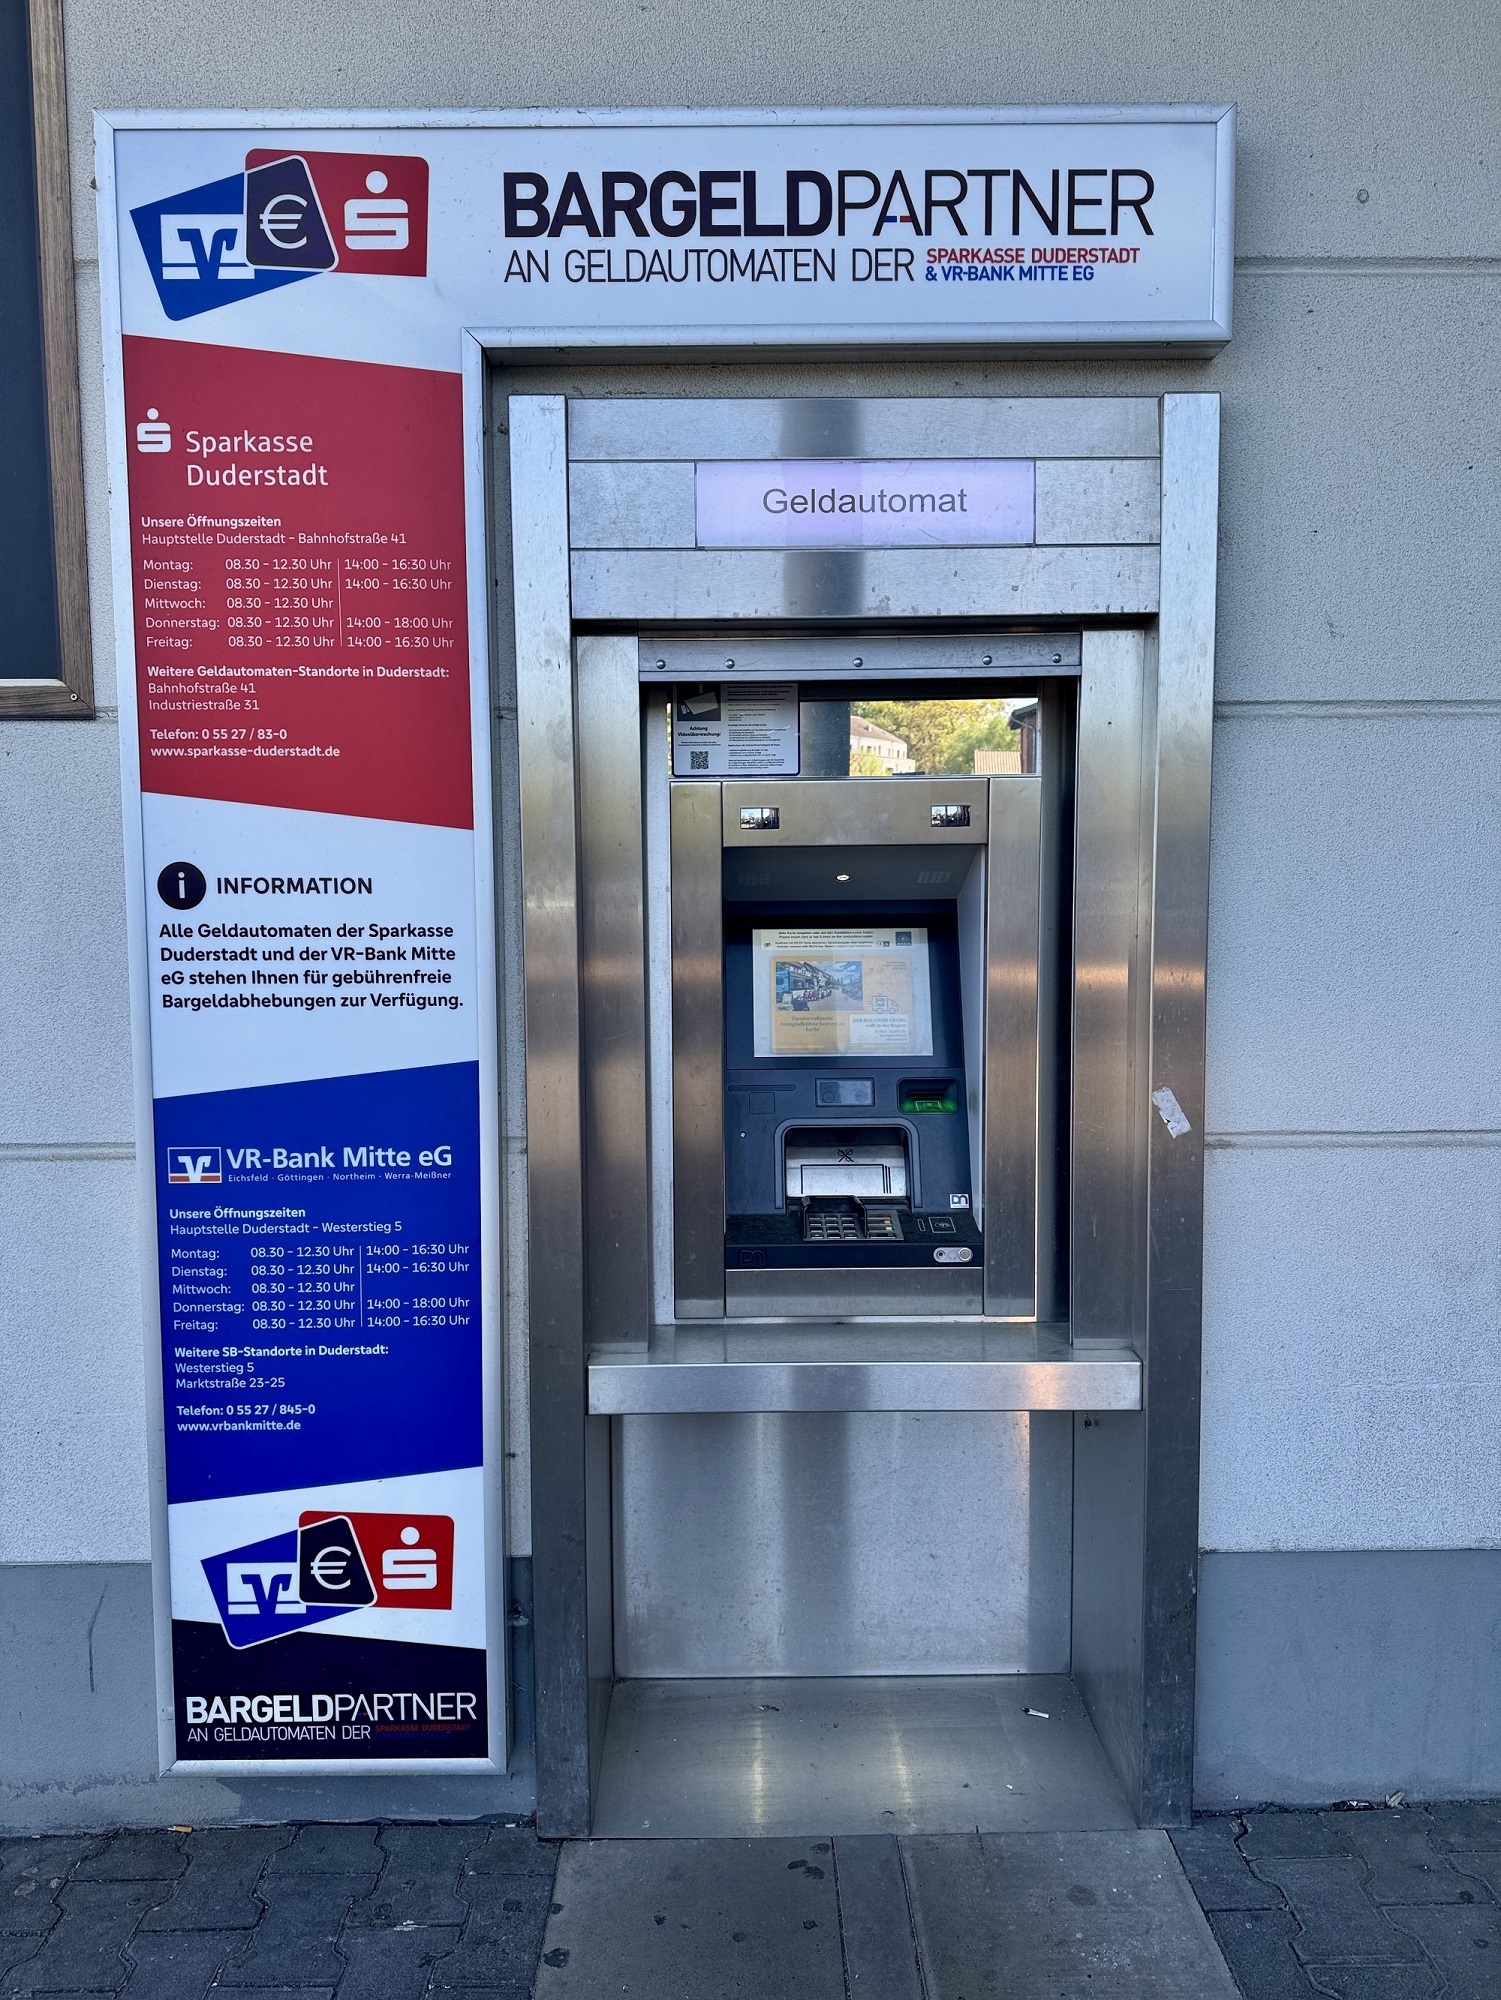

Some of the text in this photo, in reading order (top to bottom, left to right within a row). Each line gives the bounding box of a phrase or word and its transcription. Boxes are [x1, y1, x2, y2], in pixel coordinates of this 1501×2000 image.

[504, 169, 1154, 237] BARGELDPARTNER
[927, 248, 1140, 263] SPARKASSE DUDERSTADT
[504, 248, 914, 282] AN GELDAUTOMATEN DER
[926, 266, 1094, 281] & VR-BANK MITTE EG
[186, 430, 312, 458] Sparkasse
[188, 463, 328, 485] Duderstadt
[763, 489, 967, 513] Geldautomat
[142, 516, 281, 529] Unsere Öffnungszeiten
[143, 533, 406, 546] Hauptstelle Duderstadt Bahnhofstraße 41
[144, 559, 451, 572] Montag: 08.30 12.30 Uhr 14:00 16:30 Uhr
[145, 578, 452, 591] Dienstag: 08.30 12.30 Uhr 14:00 16:30 Uhr
[146, 598, 333, 608] Mittwoch: 08.30 12.30 Uhr
[146, 617, 453, 630] Donnerstag: 08.30 12.30 Uhr 14:00 18:00 Uhr
[147, 636, 454, 649] Freitag: 08.30 12.30 Uhr 14:00 16:30 Uhr
[148, 666, 449, 677] Weitere Geldautomaten-Standorte in Duderstadt:
[149, 682, 256, 693] Bahnhofstraße 41
[150, 699, 259, 710] Industriestraße 31
[150, 729, 287, 739] Telefon: 0 55 27 83-0
[151, 746, 340, 758] www.sparkasse-duderstadt.de
[217, 877, 372, 894] INFORMATION
[159, 923, 453, 940] Alle Geldautomaten der Sparkasse
[161, 946, 455, 961] Duderstadt und der VR-Bank Mitte
[161, 969, 451, 987] eG stehen Ihnen für gebührenfreie
[163, 993, 463, 1011] Bargeldabhebungen zur Verfügung.
[226, 1146, 451, 1168] VR-Bank Mitte eG
[229, 1174, 268, 1182] Eichsfeld
[278, 1174, 323, 1182] Göttingen
[385, 1171, 451, 1179] Werra-Meißner
[170, 1206, 305, 1220] Unsere Öffnungszeiten
[171, 1221, 402, 1236] Hauptstelle Duderstadt Westerstieg 5
[172, 1244, 469, 1260] Montag: 08.30 12.30 Uhr 14:00 16:30 Uhr
[172, 1262, 469, 1278] Dienstag: 08.30 12.30 Uhr 14:00 16:30 Uhr
[173, 1282, 354, 1294] Mittwoch: 08.30 12.30 Uhr
[174, 1297, 469, 1314] Donnerstag: 08.30 12.30 Uhr 14:00 18:00 Uhr
[174, 1315, 470, 1332] Freitag: 08.30 12.30 Uhr 14:00 16:30 Uhr
[175, 1344, 388, 1357] Weitere SB-Standorte in Duderstadt:
[175, 1362, 254, 1374] Westerstieg 5
[176, 1378, 285, 1388] Marktstraße 23-25
[177, 1404, 315, 1415] Telefon: 0 55 27 845-0
[177, 1420, 301, 1431] www.vrbankmitte.de
[186, 1693, 476, 1723] BARGELDPARTNER
[188, 1728, 208, 1741] AN
[215, 1726, 335, 1741] GELDAUTOMATEN
[342, 1725, 370, 1739] DER
